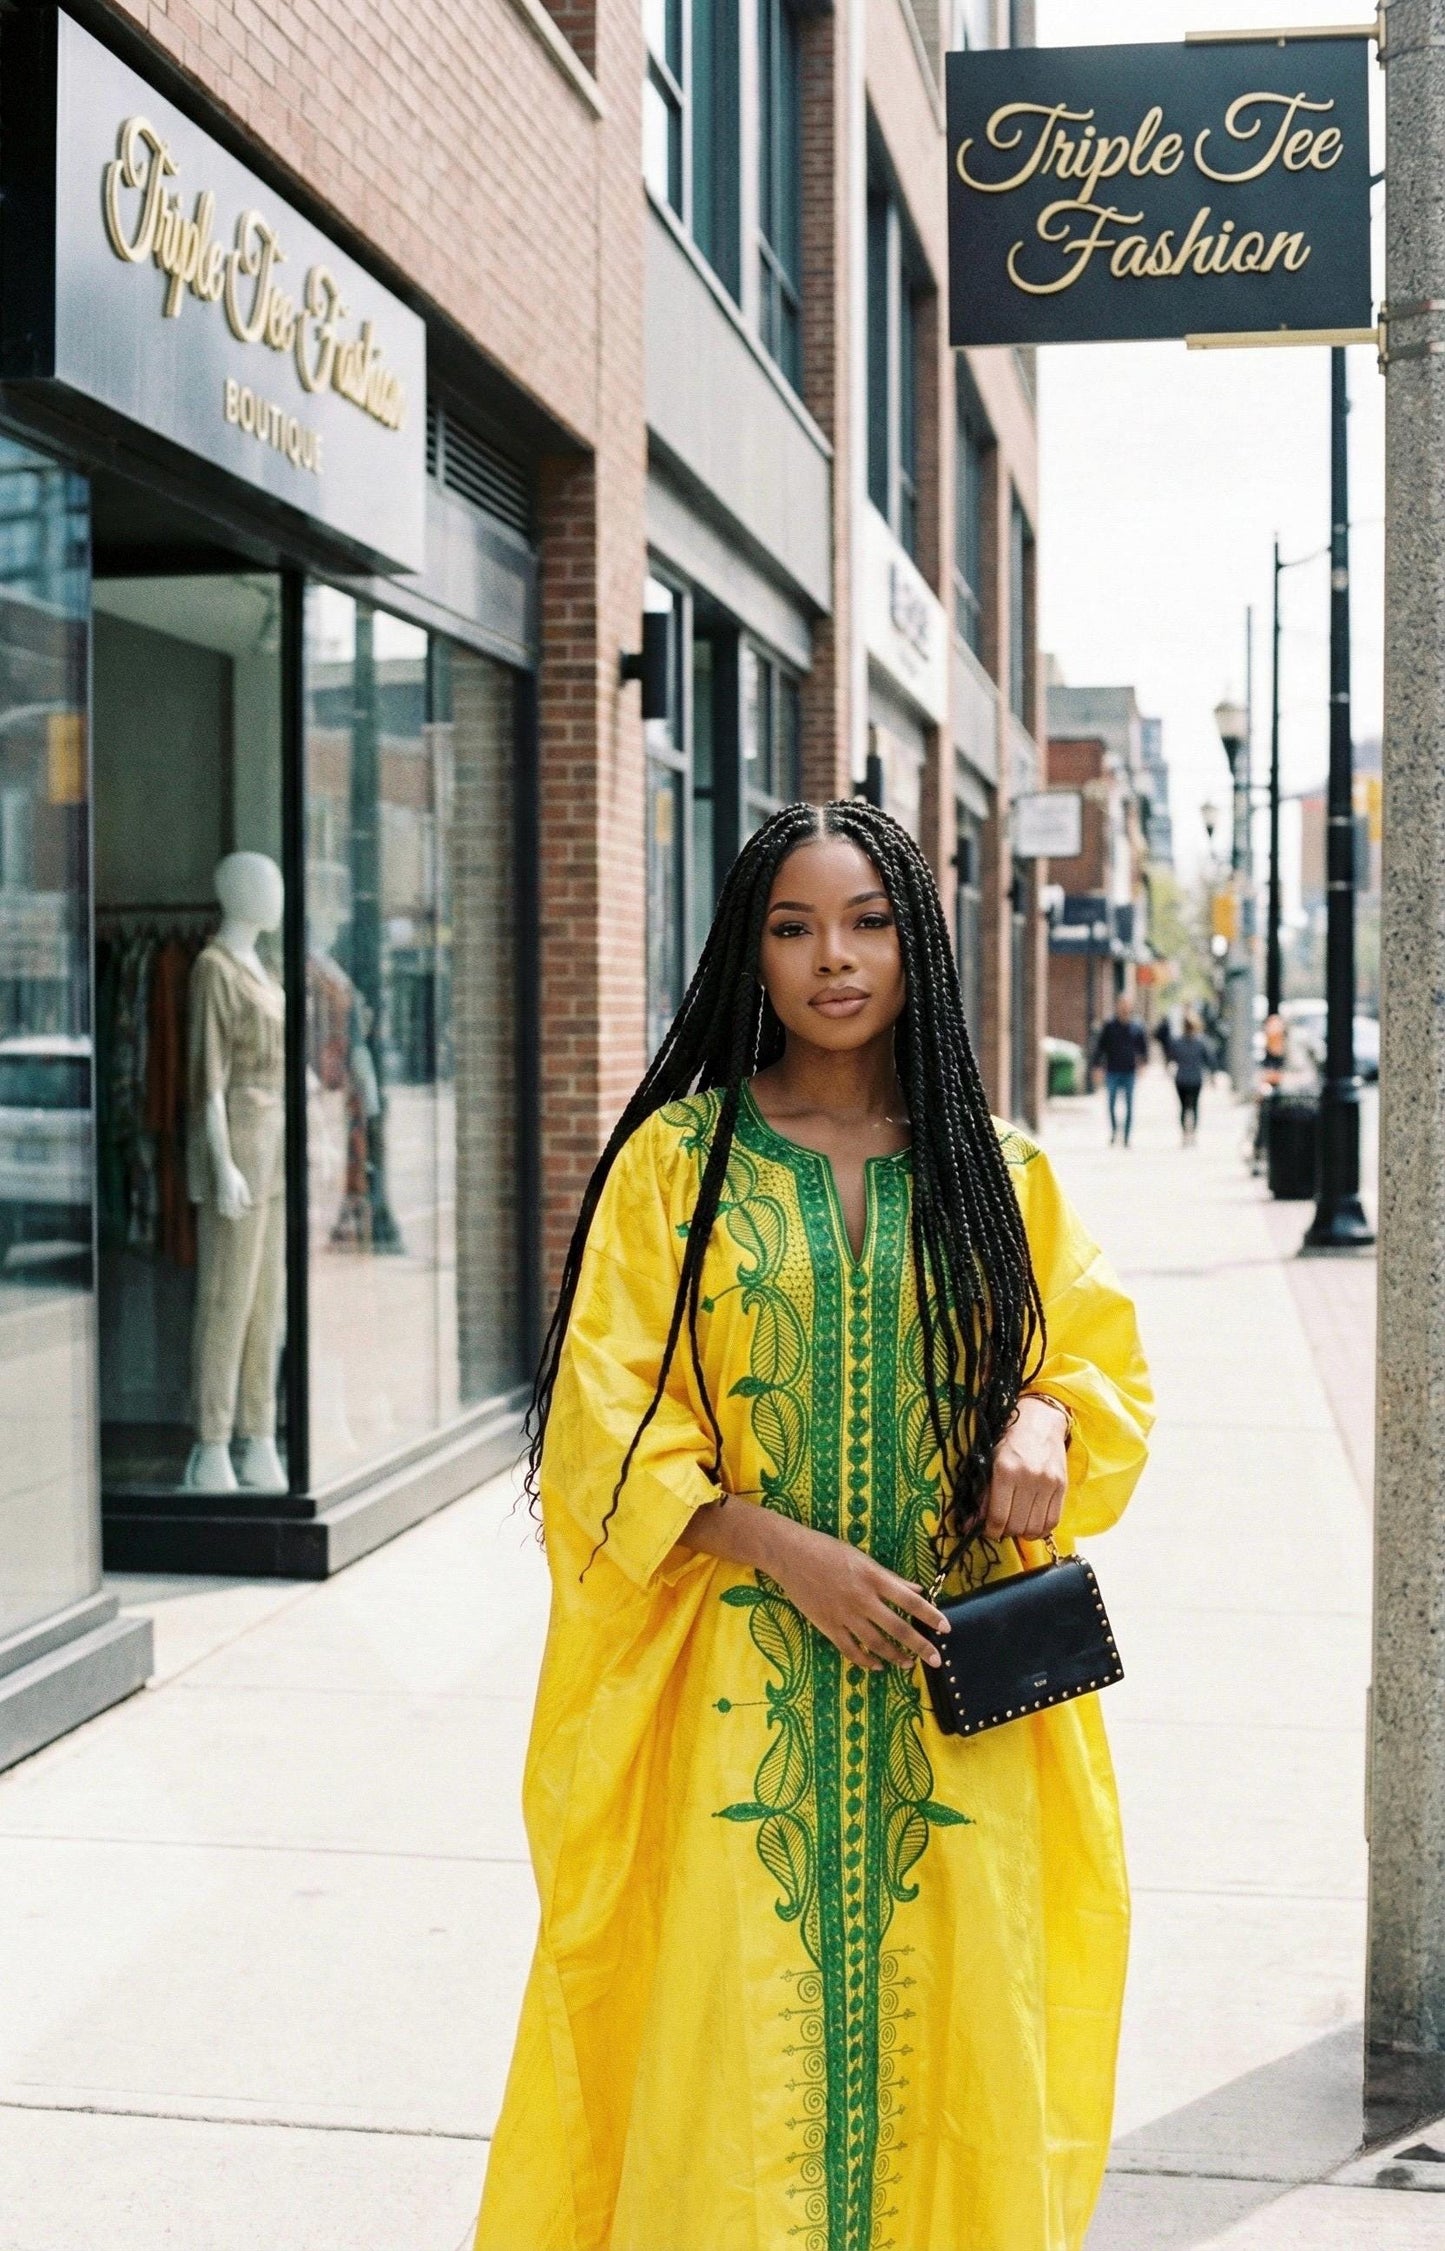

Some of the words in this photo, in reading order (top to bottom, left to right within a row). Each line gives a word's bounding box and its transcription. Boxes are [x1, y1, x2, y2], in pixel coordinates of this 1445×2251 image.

[956, 102, 1184, 203] Triple
[1194, 91, 1343, 182] Tee
[104, 115, 224, 318] Triple
[223, 209, 297, 352] Tee
[295, 265, 404, 430] Fashion
[1006, 199, 1311, 295] Fashion
[223, 377, 324, 474] BOUTIQUE
